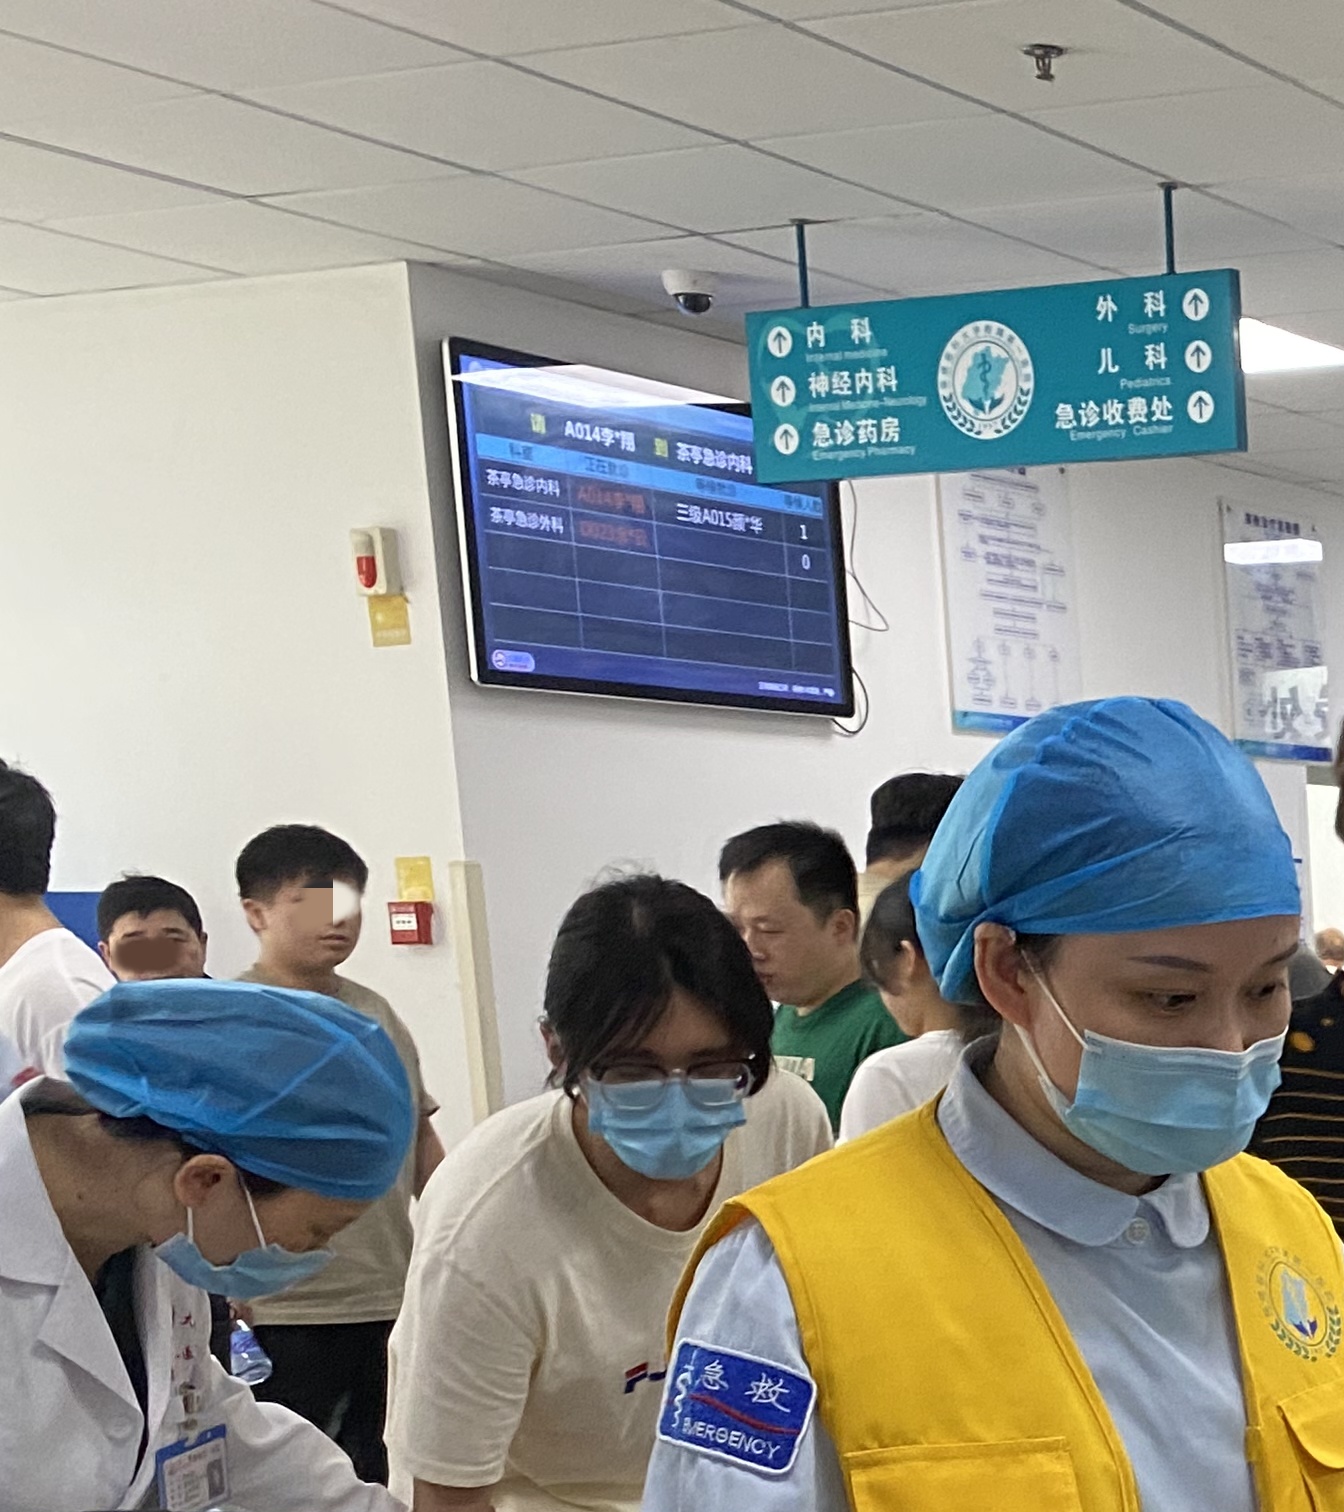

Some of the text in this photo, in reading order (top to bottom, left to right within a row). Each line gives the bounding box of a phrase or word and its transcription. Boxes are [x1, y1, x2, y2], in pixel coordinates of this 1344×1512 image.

[1096, 289, 1166, 323] 外科
[806, 317, 871, 348] 内科
[1128, 322, 1168, 335] Surgery
[1097, 342, 1168, 374] 儿科
[808, 365, 898, 398] 神经内科
[1119, 376, 1171, 390] Pediatrics
[1055, 395, 1173, 430] 急诊收费处
[812, 417, 901, 448] 急诊药房
[1070, 428, 1126, 441] Emergency
[676, 442, 753, 475] 茶亭急诊内科
[486, 468, 560, 498] 茶亭急诊内科
[799, 524, 807, 539] 1
[489, 506, 564, 535] 茶亭急诊外科
[801, 555, 811, 570] 0
[701, 1359, 791, 1413] 急救
